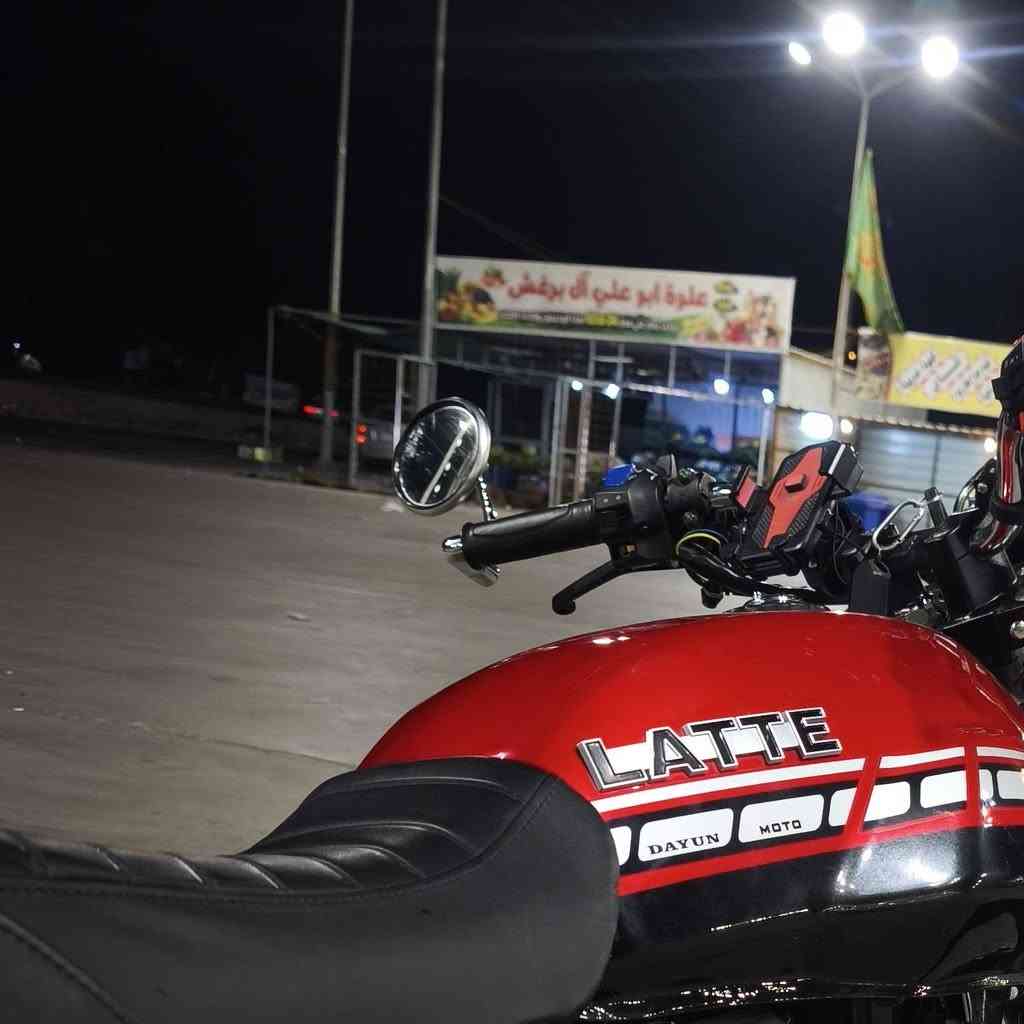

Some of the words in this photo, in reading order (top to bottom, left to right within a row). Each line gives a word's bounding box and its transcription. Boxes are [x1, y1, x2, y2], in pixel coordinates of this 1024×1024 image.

[576, 707, 842, 791] LATTE
[647, 833, 721, 855] DAYUN
[759, 819, 803, 836] MOTO
